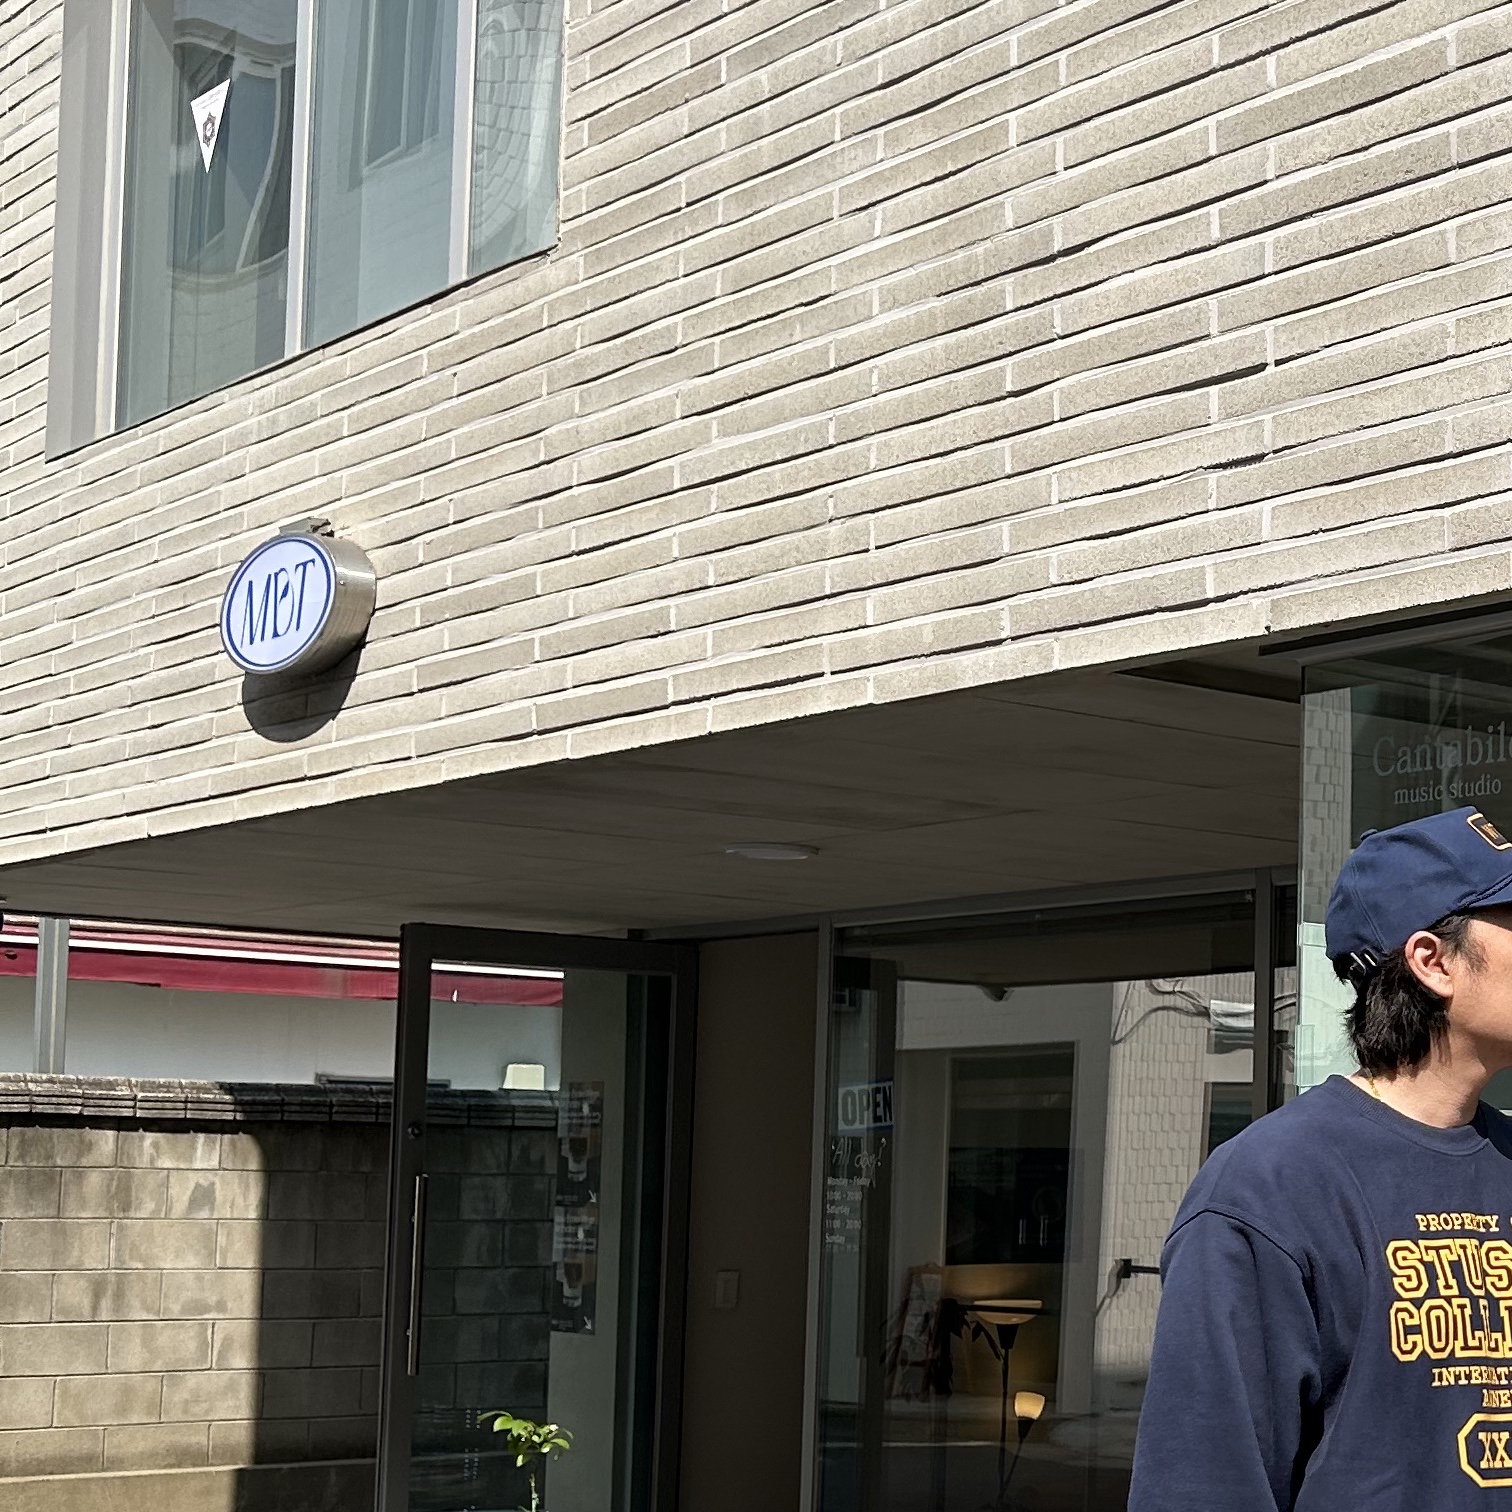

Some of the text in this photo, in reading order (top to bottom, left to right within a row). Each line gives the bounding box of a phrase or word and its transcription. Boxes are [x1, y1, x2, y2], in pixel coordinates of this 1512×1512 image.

[1394, 773, 1502, 805] music studio
[841, 1085, 893, 1127] OPEN
[1415, 1212, 1500, 1233] PROPETY
